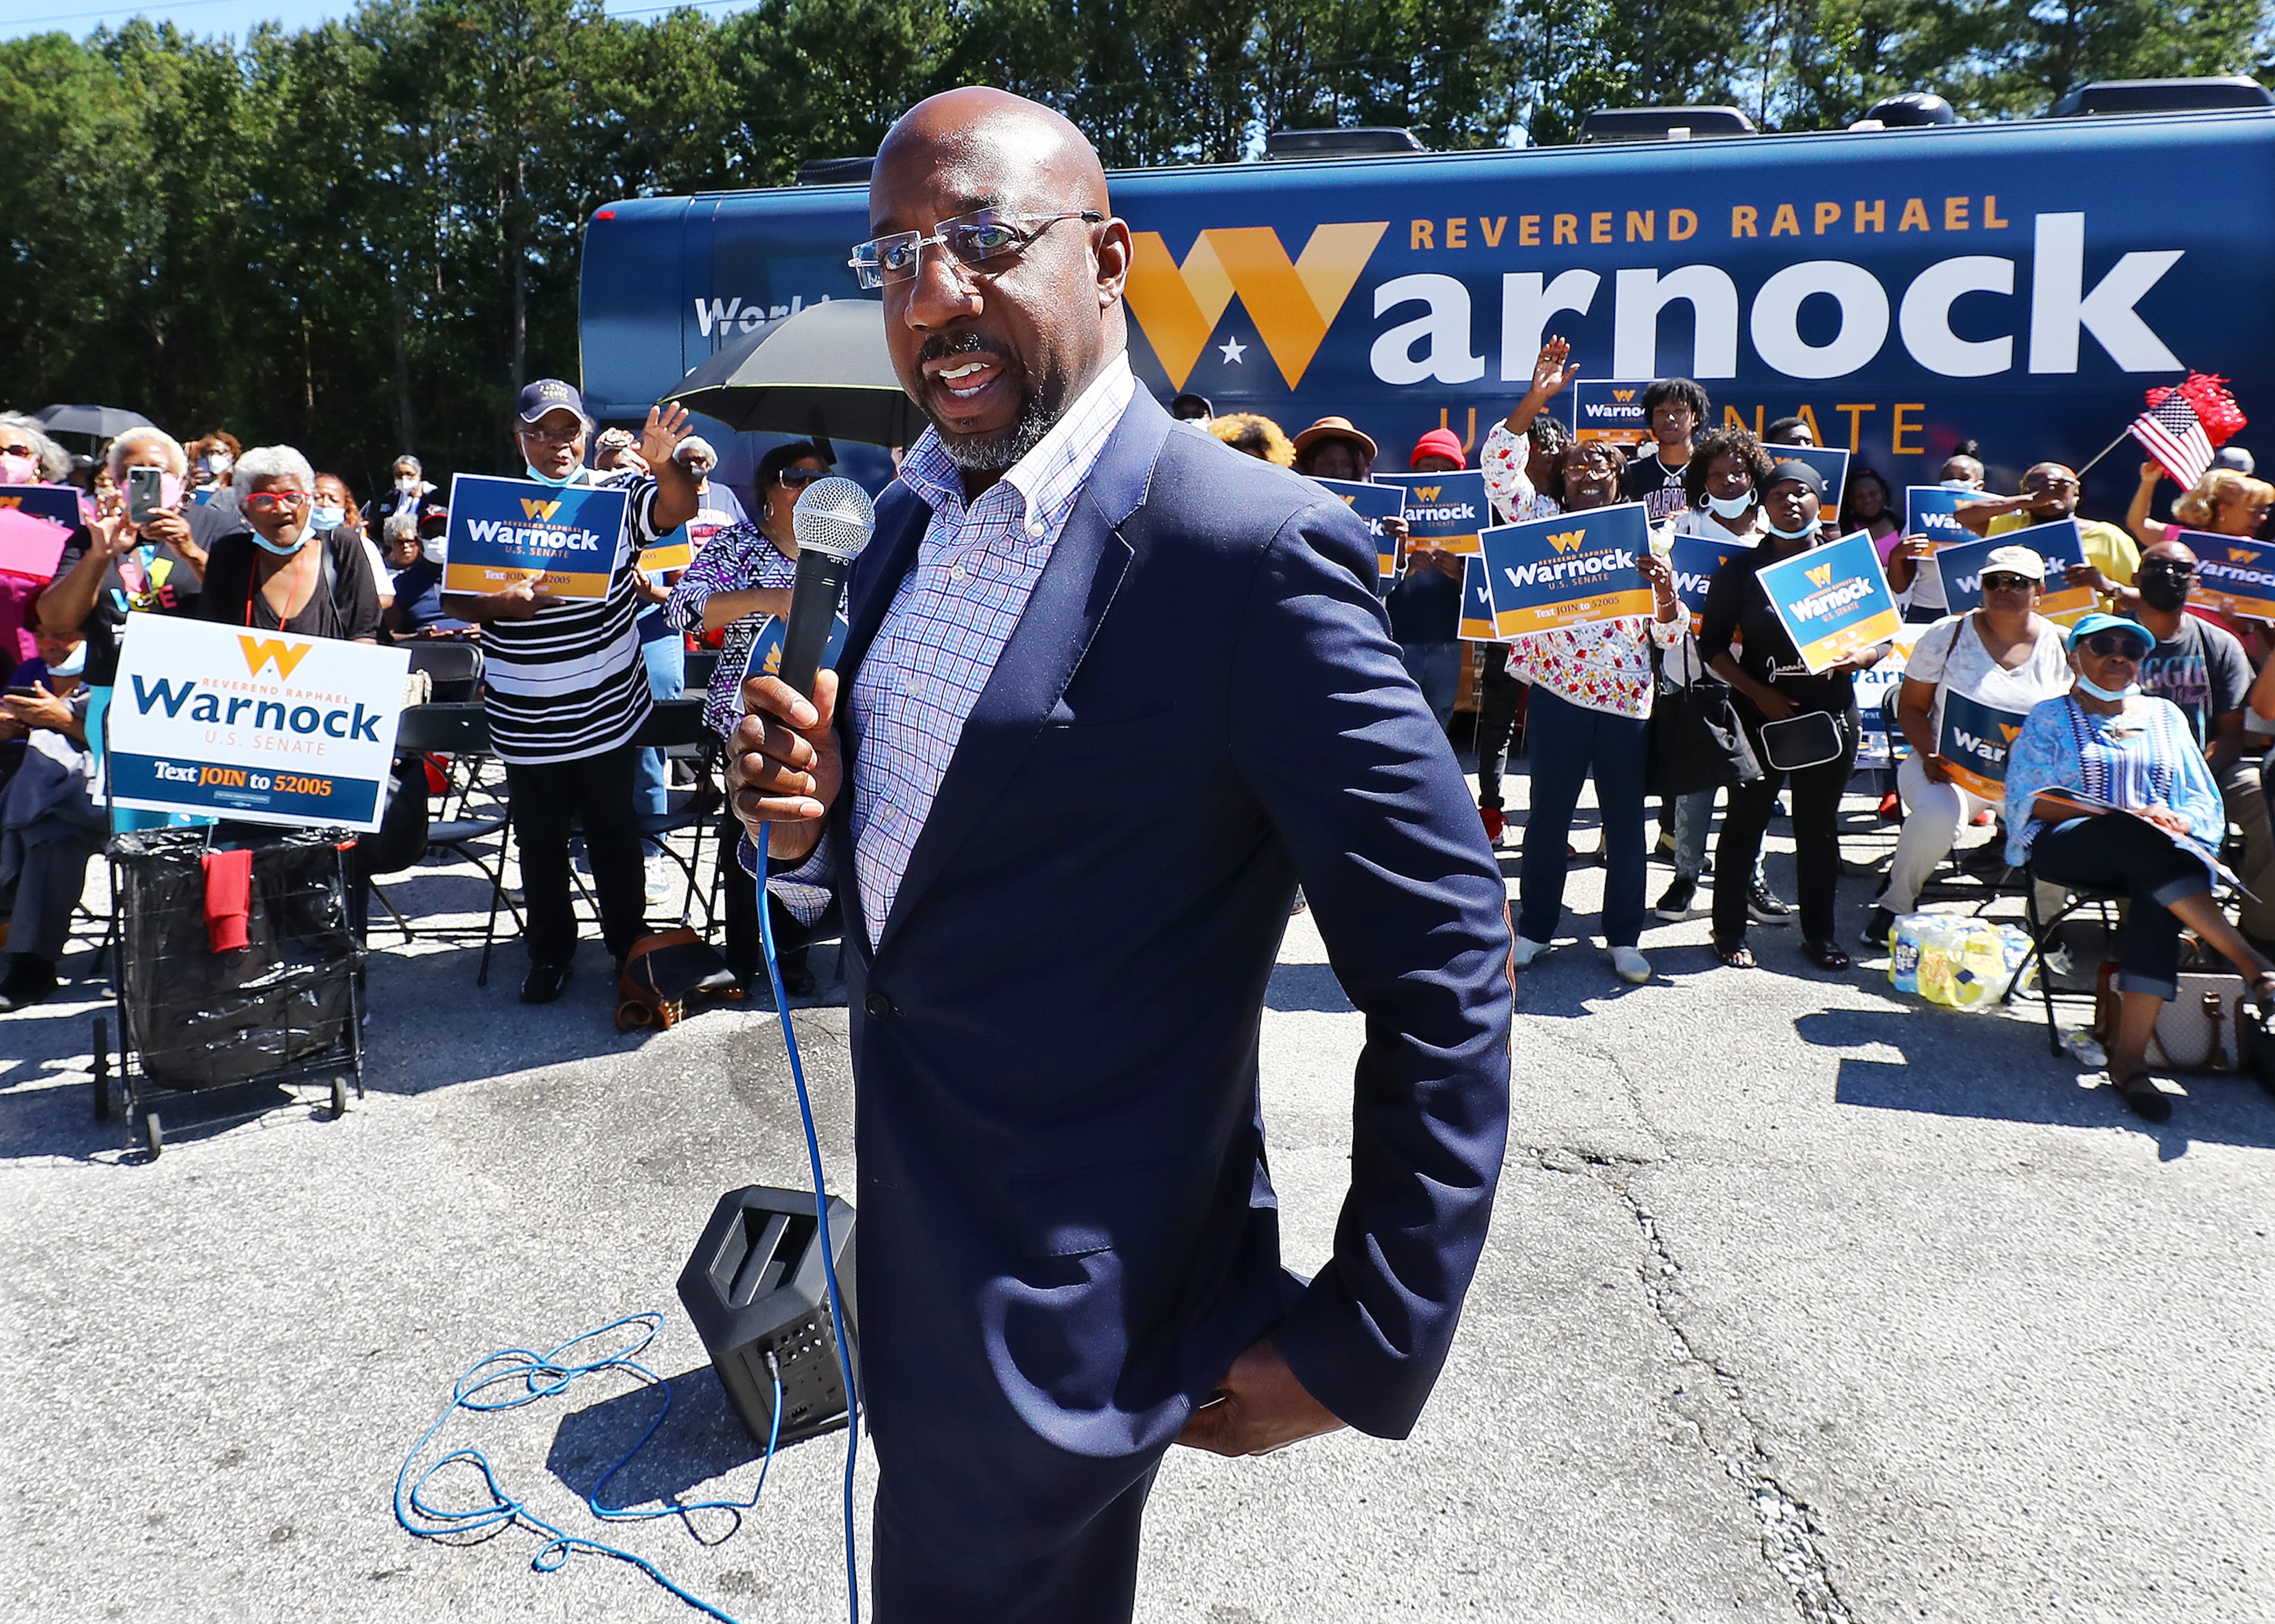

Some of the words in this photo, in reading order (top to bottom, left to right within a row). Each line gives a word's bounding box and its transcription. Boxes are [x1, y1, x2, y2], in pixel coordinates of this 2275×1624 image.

[1409, 209, 1699, 249] REVEREND
[1732, 195, 2009, 238] RAPHAEL
[1585, 403, 1646, 418] Warno
[1723, 403, 1925, 455] NATE
[1405, 503, 1476, 522] arnock
[466, 518, 600, 552] Warnock
[529, 546, 569, 559] SENATE
[1538, 555, 1577, 566] REVEREND
[1579, 548, 1613, 559] RAPHAEL
[484, 569, 505, 580] Text
[1504, 547, 1636, 588] Warnock
[1548, 580, 1568, 590] U.S.
[1572, 572, 1609, 586] SENATE
[1534, 607, 1556, 619] Text
[1557, 603, 1578, 616] JOIN
[1579, 602, 1591, 611] to
[1592, 596, 1620, 608] 52005
[1788, 576, 1875, 623] Warnock
[202, 677, 279, 696] REVEREND
[286, 688, 350, 705] RAPHAEL
[130, 674, 383, 743] Warnock
[204, 729, 243, 747] U.S.
[253, 735, 326, 757] SENATE
[154, 761, 198, 783] Text
[198, 765, 248, 787] JOIN
[249, 773, 271, 790] to
[273, 774, 333, 797] 52005
